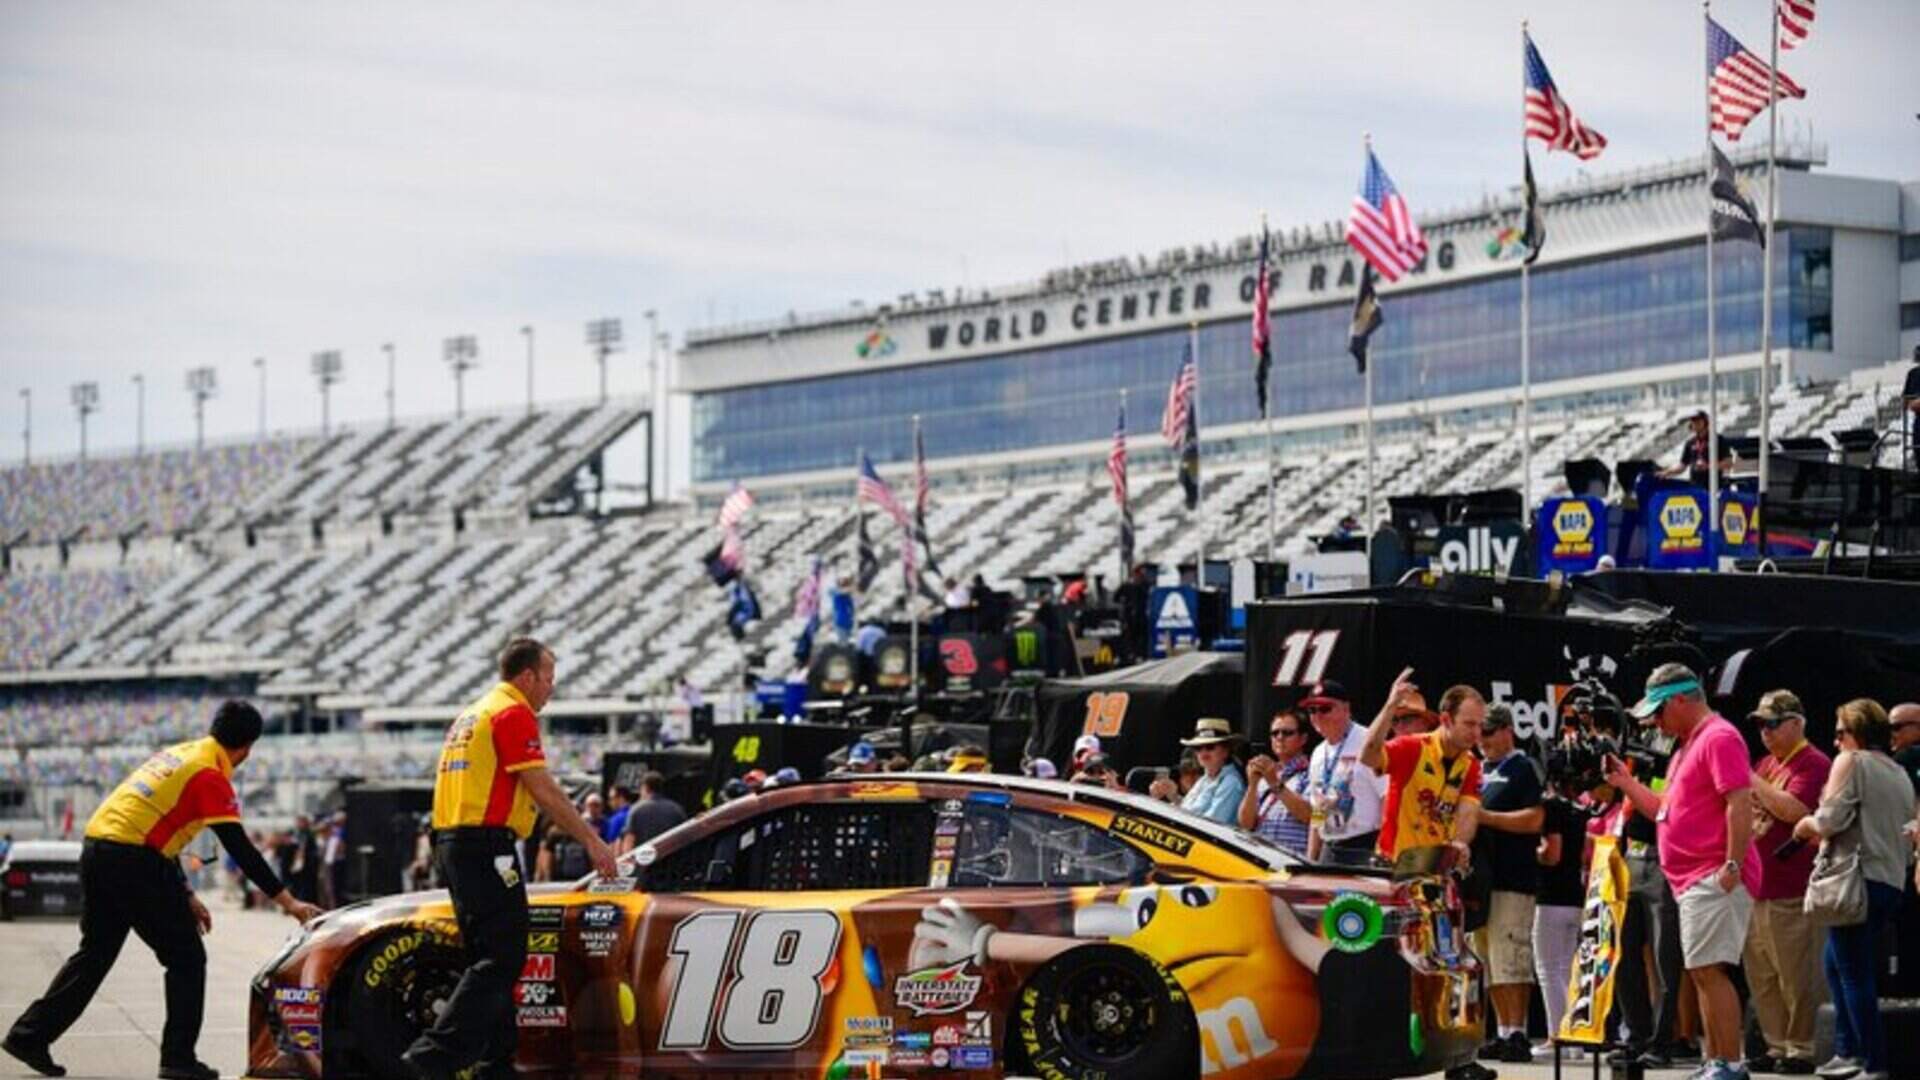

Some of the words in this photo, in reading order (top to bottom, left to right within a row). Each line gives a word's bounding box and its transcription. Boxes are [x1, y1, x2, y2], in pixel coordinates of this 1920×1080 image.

[928, 309, 1047, 349] WORLD
[1071, 283, 1211, 329] CENTER
[1559, 513, 1588, 531] NAPA
[1667, 507, 1696, 526] NAPA
[1440, 527, 1519, 577] ally
[939, 638, 978, 675] 3
[1272, 630, 1341, 686] 11
[1083, 691, 1130, 737] 19
[1115, 816, 1188, 853] STANLEY
[584, 910, 616, 921] HEAT
[275, 987, 321, 1003] MOOG
[658, 907, 843, 1051] 18
[899, 979, 976, 991] INTERSTATE
[902, 991, 971, 1002] BATTERIES
